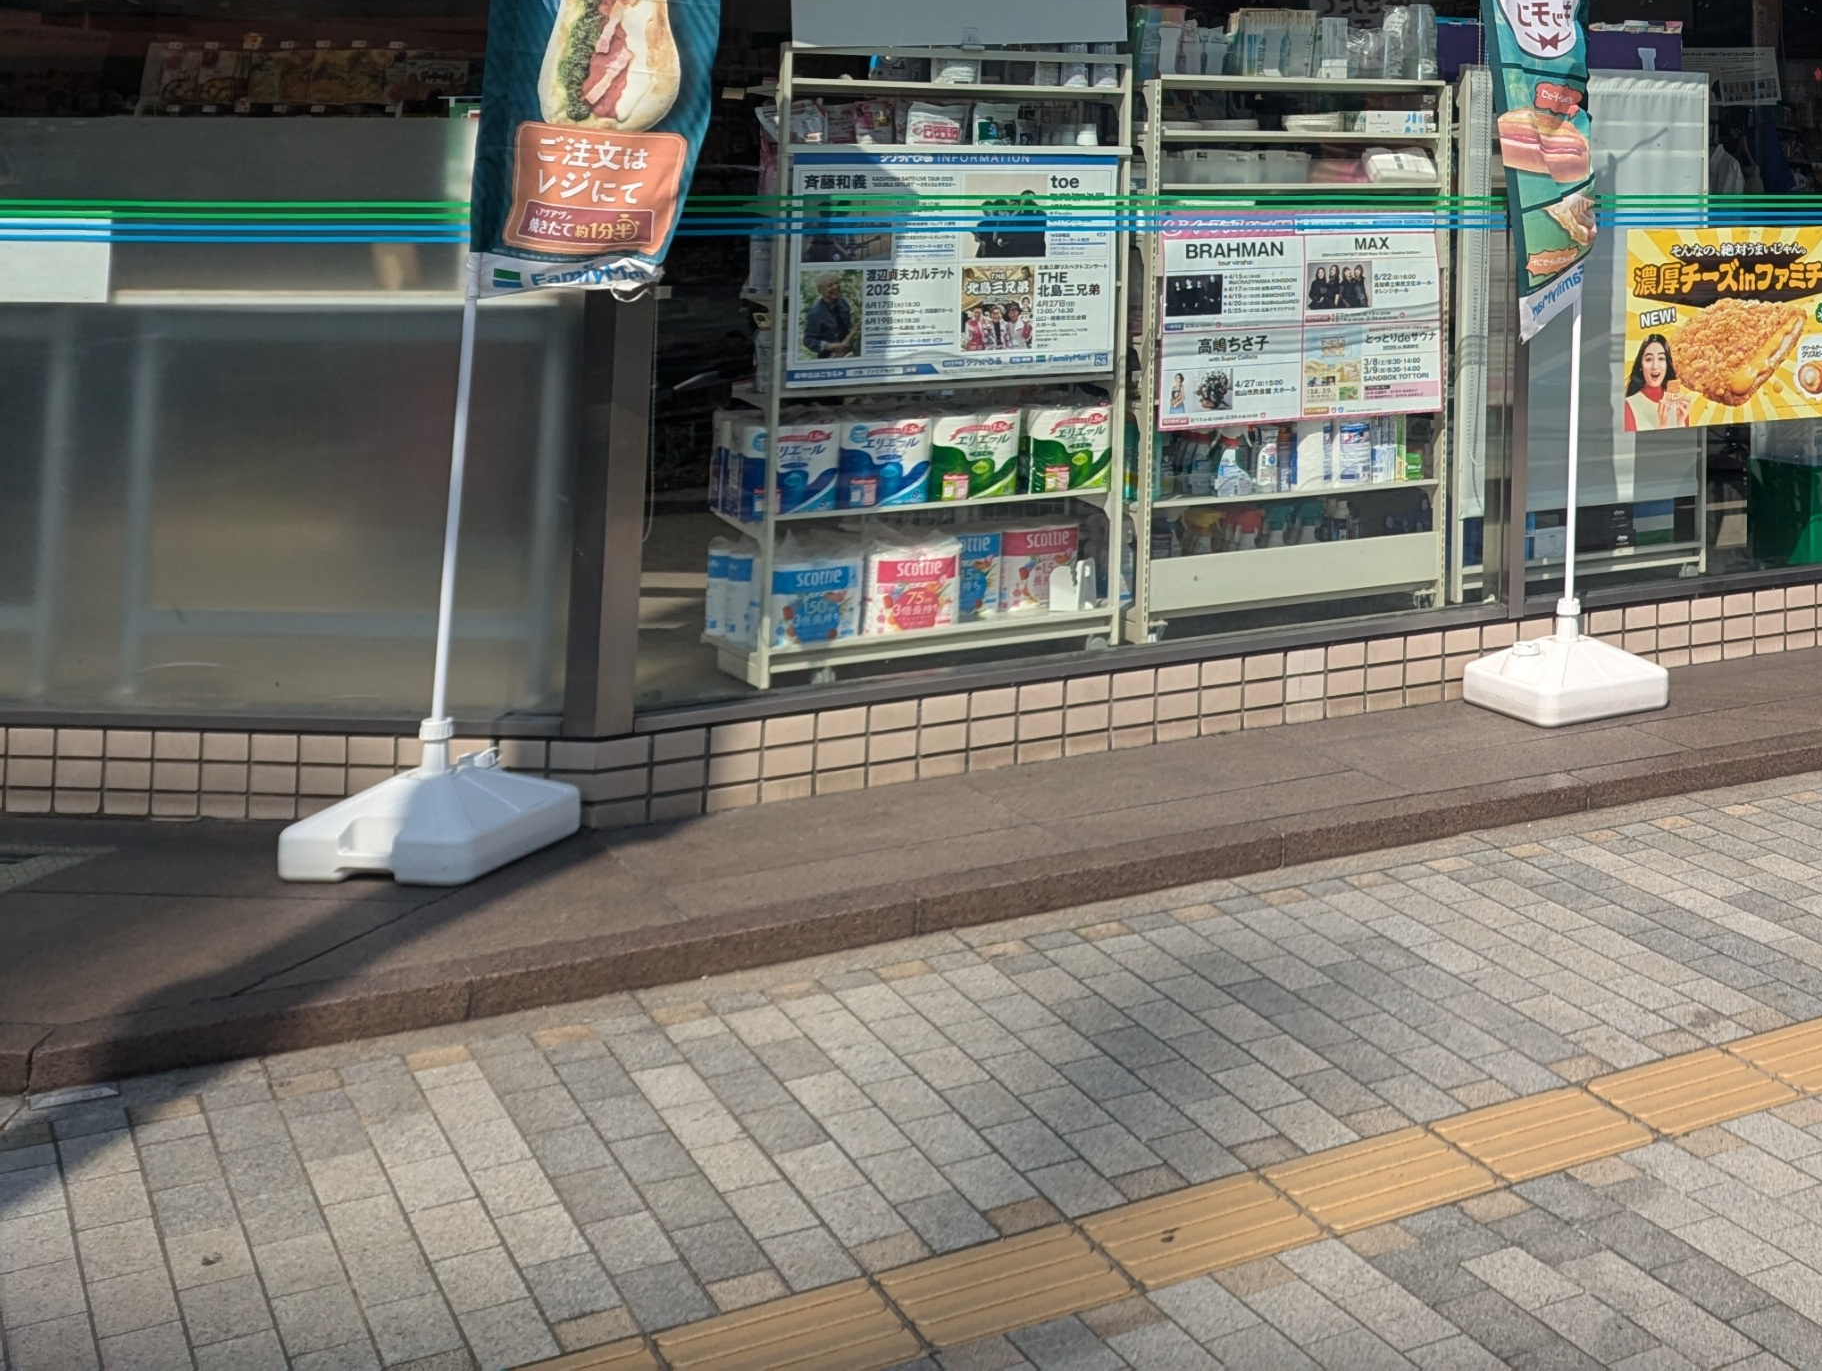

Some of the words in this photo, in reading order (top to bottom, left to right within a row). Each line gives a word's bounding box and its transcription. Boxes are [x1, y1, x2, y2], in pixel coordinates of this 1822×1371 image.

[537, 135, 649, 171] ご注文は
[537, 169, 644, 205] レジにて
[803, 175, 867, 190] 斉藤和義
[1050, 175, 1079, 189] toe
[527, 217, 575, 238] 焼きたて
[1186, 241, 1284, 259] BRAHMAN
[1354, 237, 1389, 250] MAX
[1670, 242, 1807, 256] そんなの、絶対うまいじゃん。
[1038, 272, 1068, 283] THE
[866, 284, 899, 296] 2025
[966, 280, 1029, 295] 北島三兄弟
[1037, 284, 1100, 297] 北島三兄弟
[1640, 307, 1677, 328] NEW!
[1365, 331, 1436, 343] とっとりdeサウナ
[1198, 335, 1269, 354] 高嶋ちさ子
[1048, 354, 1091, 362] FamilyMart
[1056, 426, 1106, 437] エリエール
[862, 436, 920, 450] エリエール
[955, 434, 1011, 446] エリエール
[1026, 532, 1070, 548] scottie
[896, 561, 943, 577] scottie
